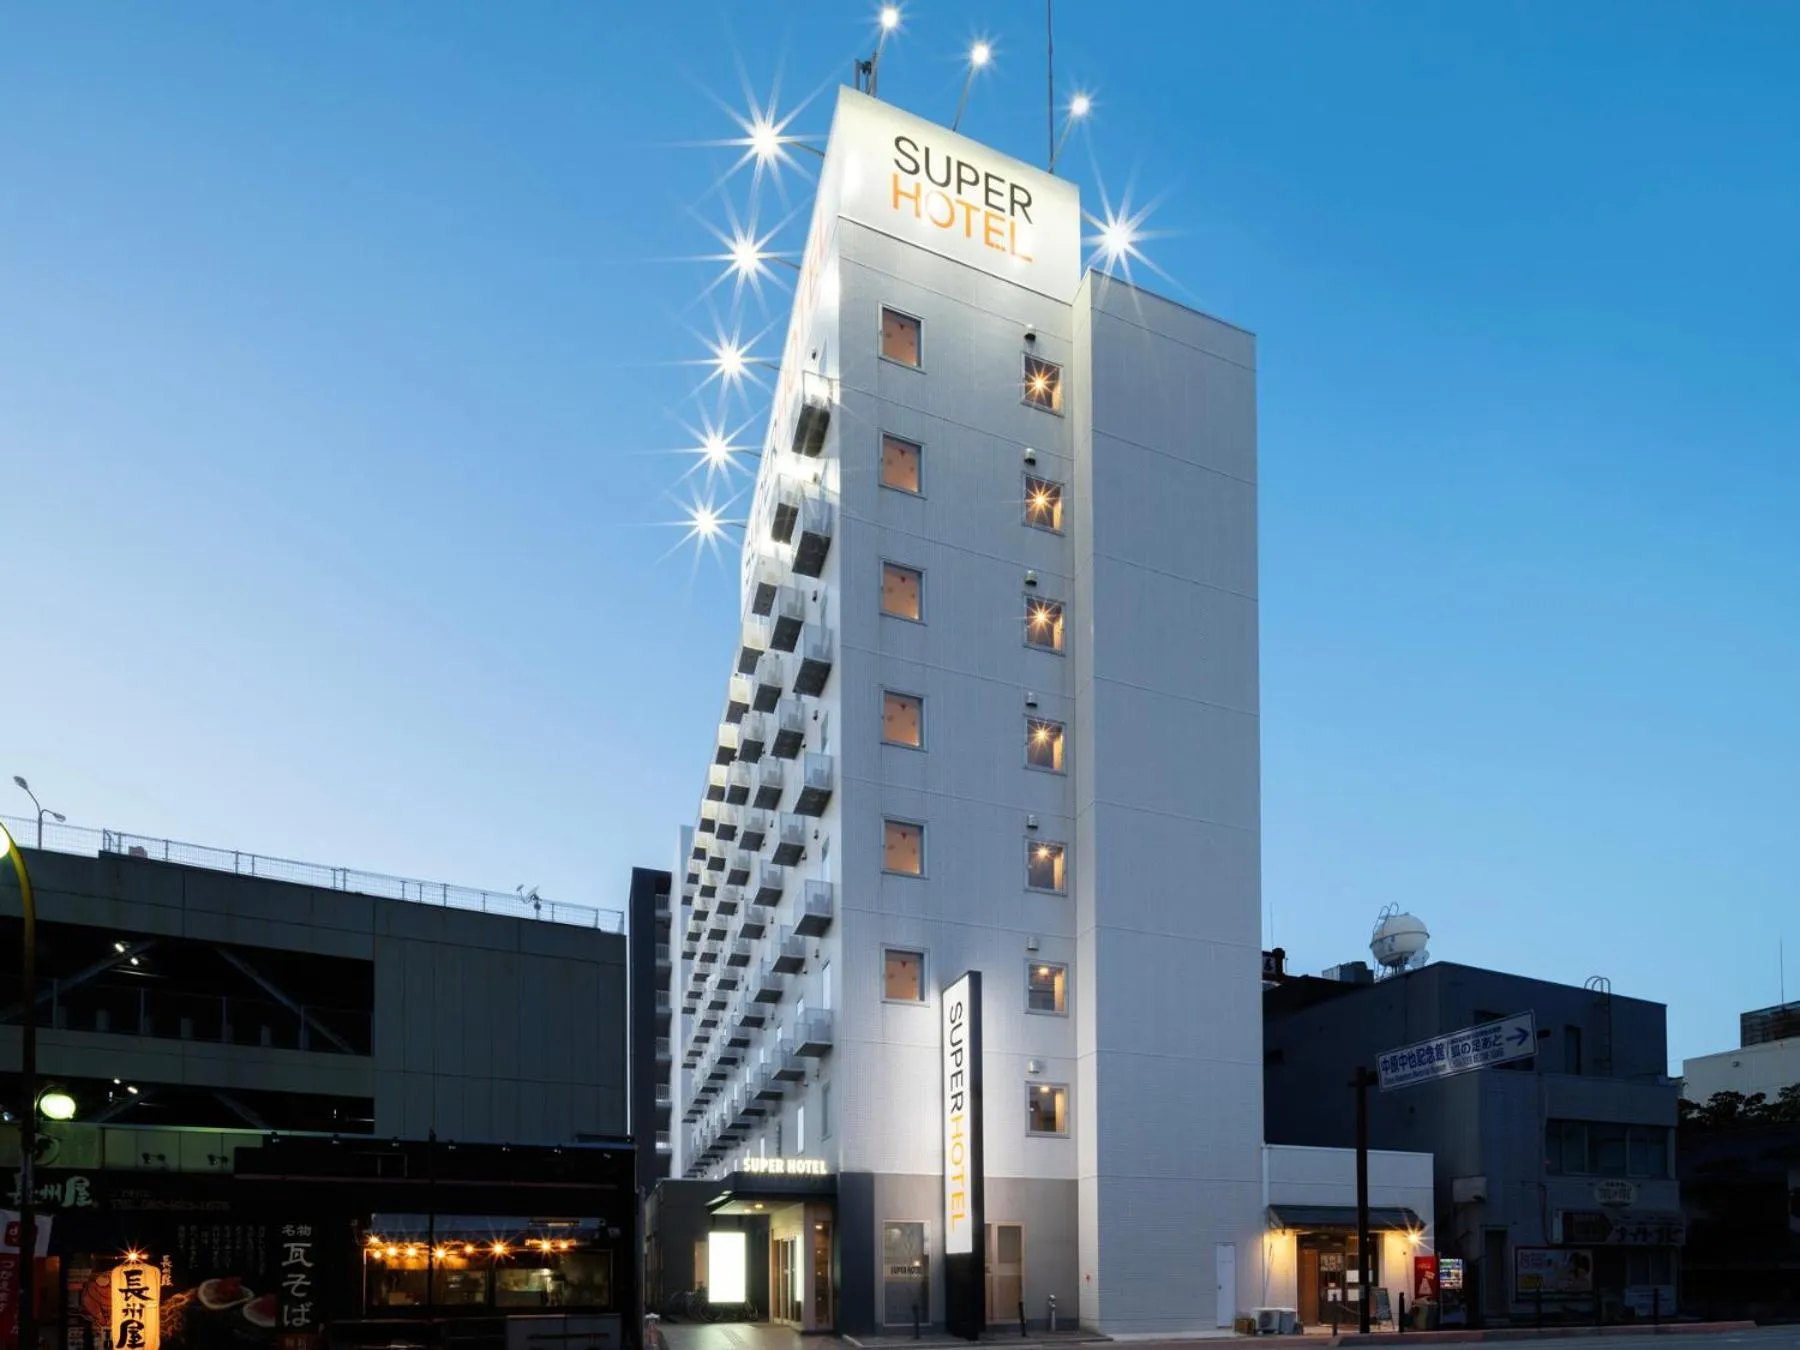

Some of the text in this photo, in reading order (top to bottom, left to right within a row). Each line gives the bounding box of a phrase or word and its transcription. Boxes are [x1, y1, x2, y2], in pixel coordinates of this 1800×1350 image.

[892, 173, 1033, 262] HOTEL
[893, 135, 1033, 225] SUPER
[743, 1157, 827, 1174] SUPER HOTEL
[281, 1223, 313, 1237] 名物
[116, 1269, 155, 1349] 長州屋
[279, 1242, 315, 1328] 瓦そば
